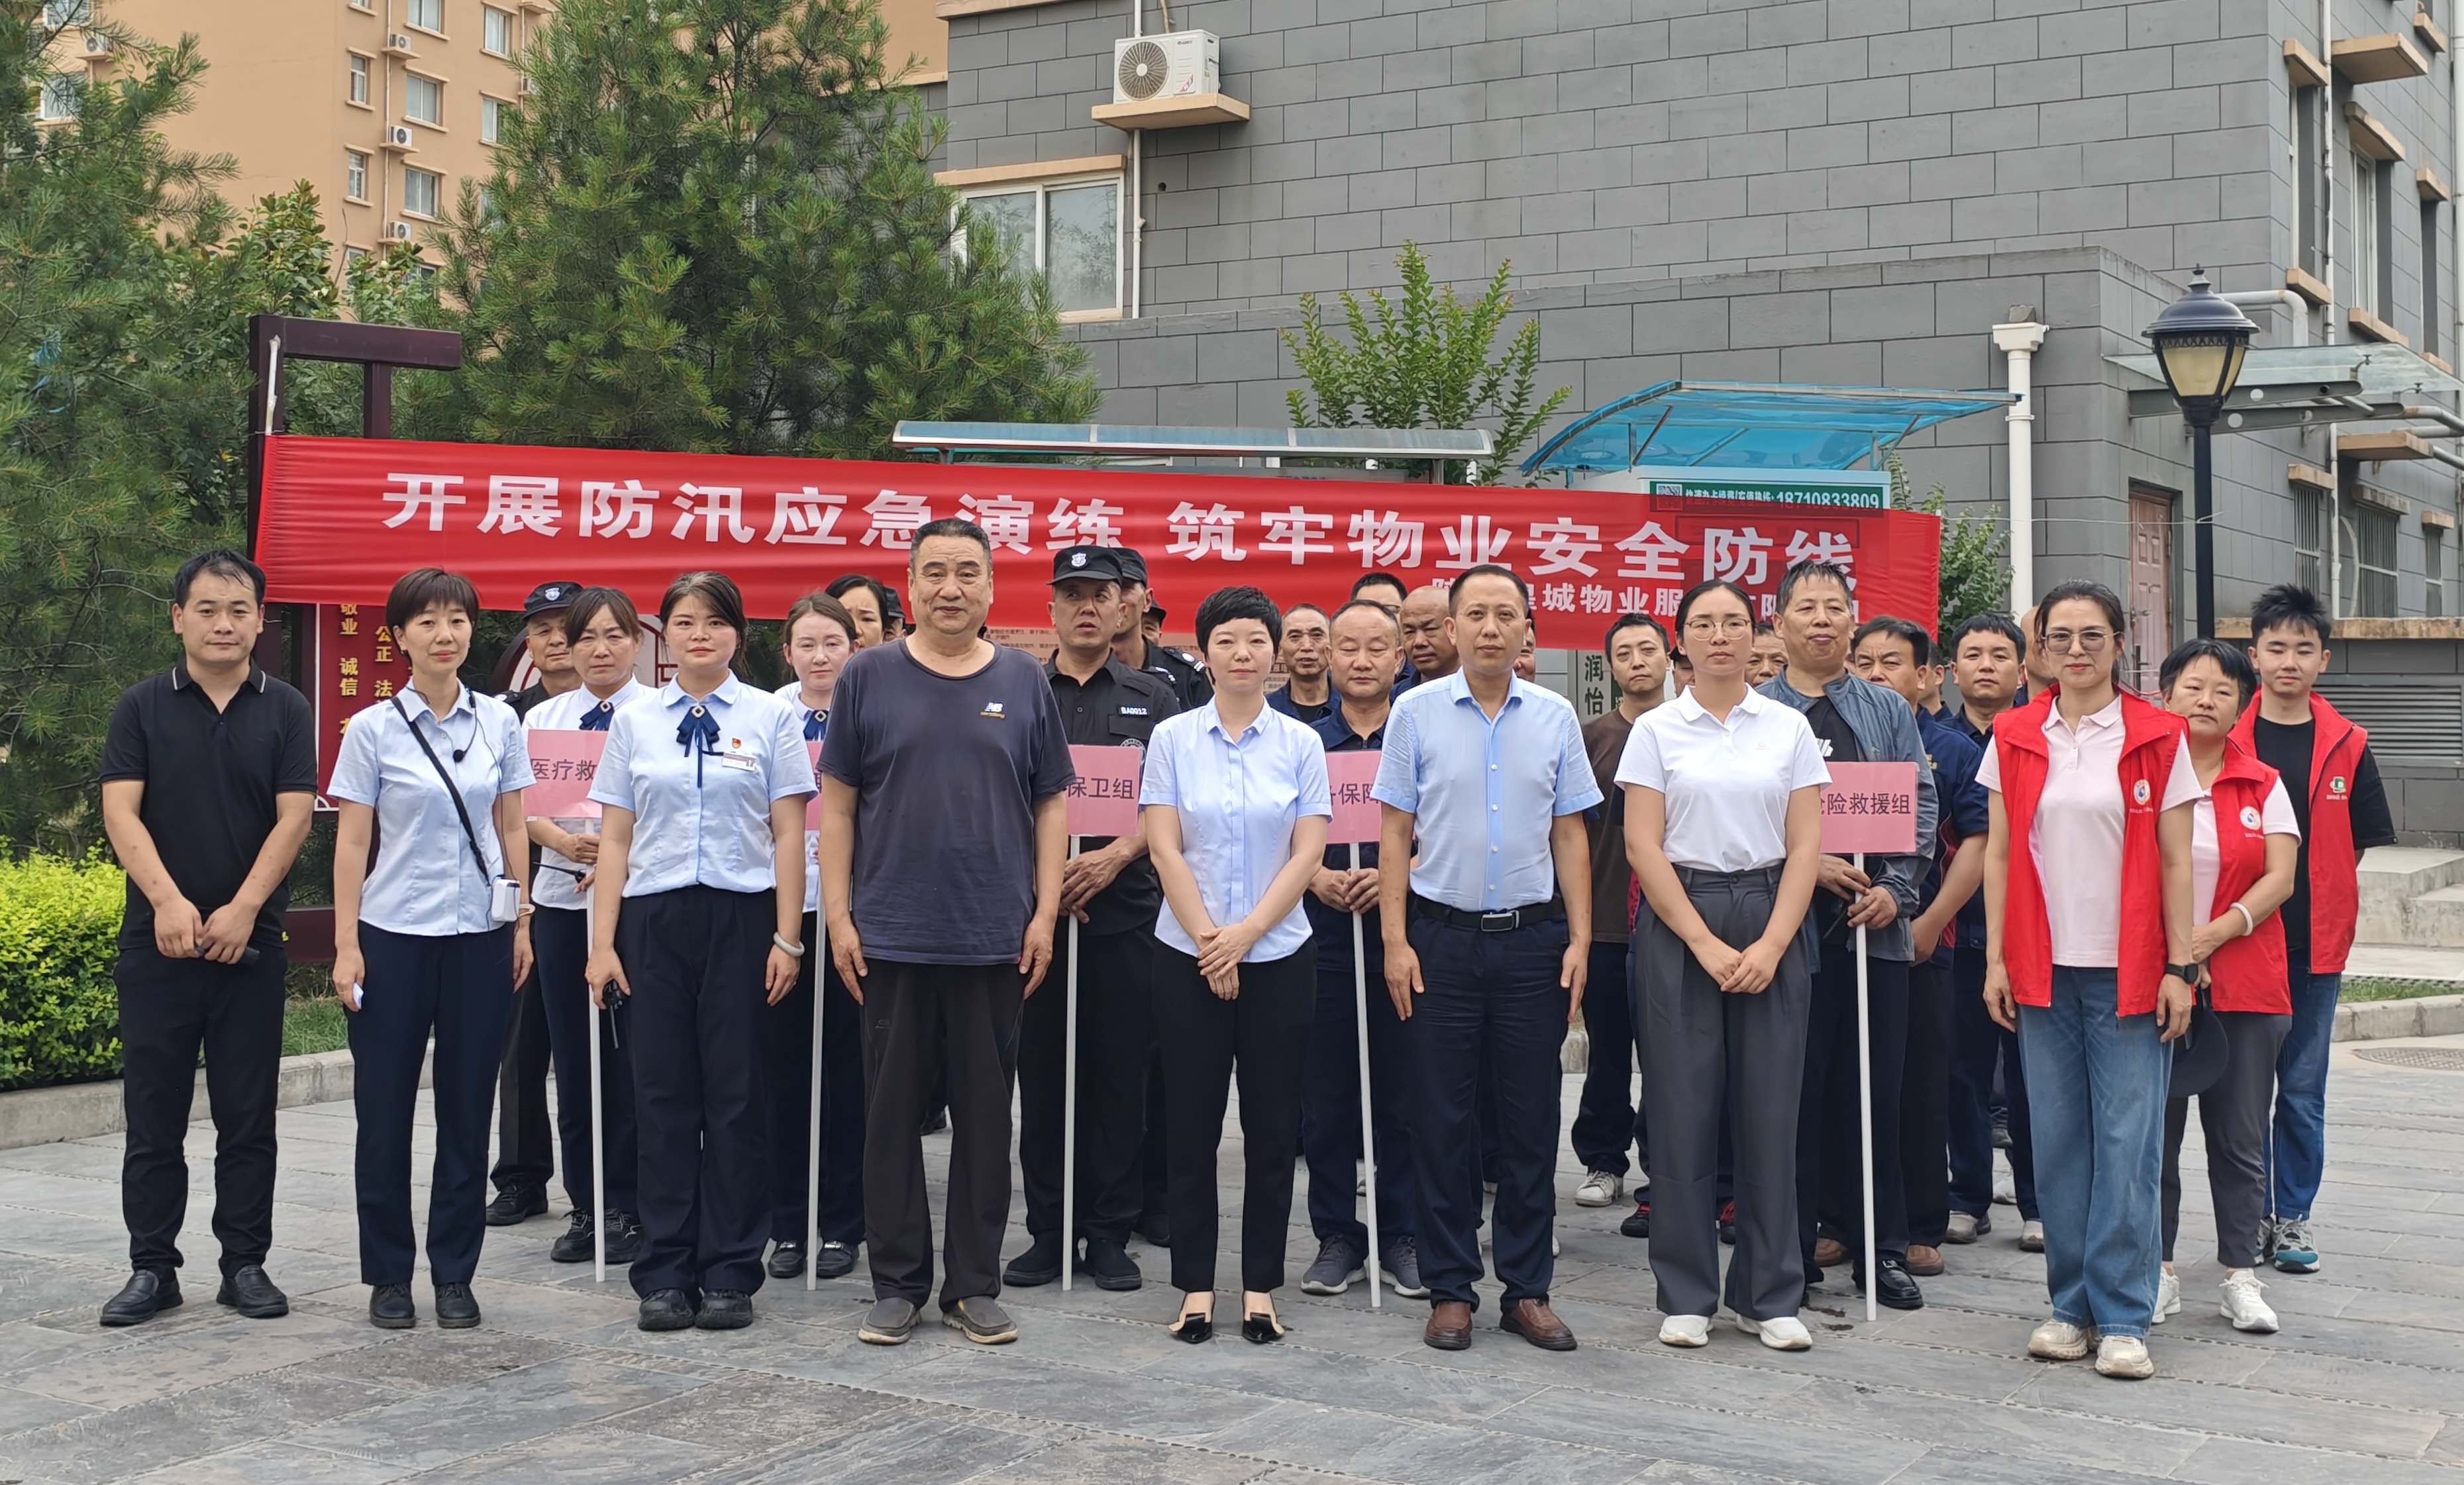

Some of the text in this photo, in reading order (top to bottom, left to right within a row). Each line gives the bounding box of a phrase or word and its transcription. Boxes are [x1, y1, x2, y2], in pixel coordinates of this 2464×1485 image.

[1776, 491, 1880, 509] 18710833809
[382, 472, 1857, 592] 开展防汛应急演练 筑牢物业安全防线
[374, 625, 393, 662] 公正
[339, 657, 358, 696] 诚信
[1584, 654, 1604, 715] 润怡
[1820, 793, 1912, 815] 险救援组
